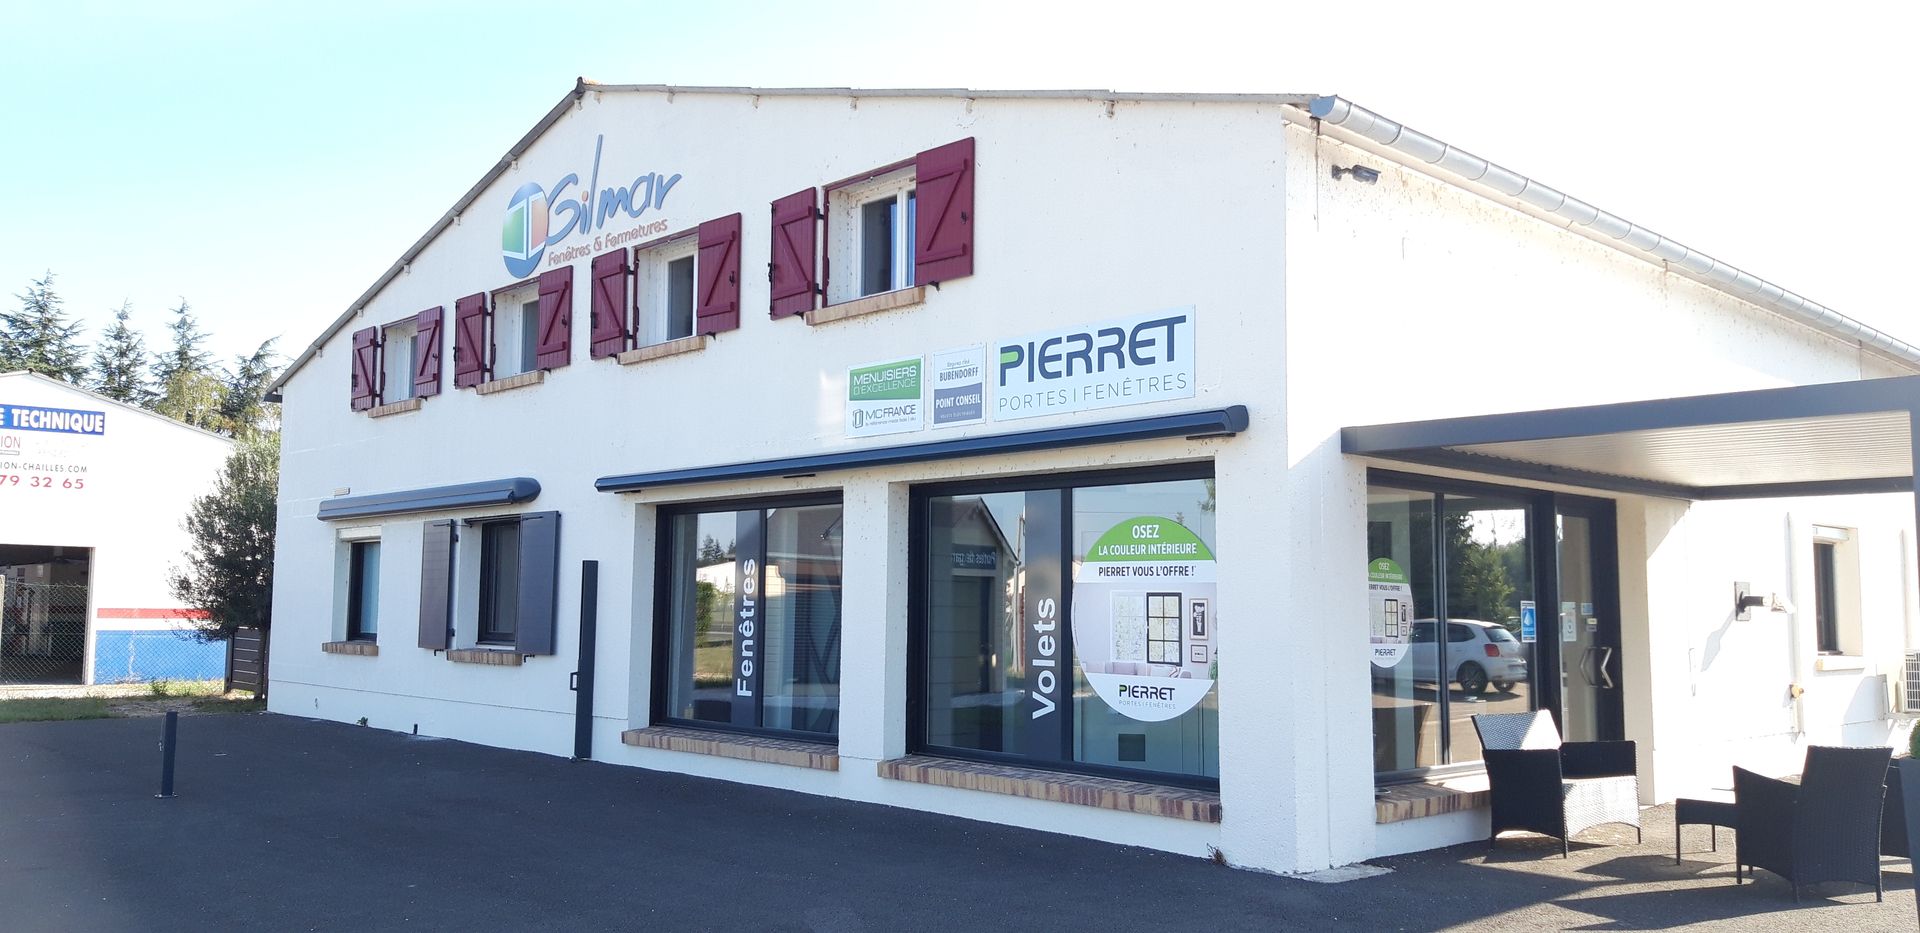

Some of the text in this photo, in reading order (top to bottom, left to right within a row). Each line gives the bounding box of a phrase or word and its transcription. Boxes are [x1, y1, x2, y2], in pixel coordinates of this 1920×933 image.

[545, 134, 682, 246] Gilmar
[593, 236, 603, 252] &
[1000, 315, 1186, 386] PIERRET
[853, 366, 917, 386] MENUISIERS
[940, 366, 979, 382] BUBENDORFF
[1000, 372, 1187, 412] PORTES FENÊTRES
[936, 393, 981, 409] POINT CONSEIL
[11, 408, 104, 432] TECHNIQUE
[30, 476, 52, 488] 32
[62, 478, 84, 490] 65
[1132, 524, 1159, 539] OSEZ
[1098, 541, 1197, 556] LA COULEUR INTÉRIEURE
[1098, 566, 1130, 577] PIERRET
[1132, 566, 1154, 577] VOUS
[1156, 566, 1189, 577] L'OFFRE
[737, 558, 755, 697] Fenêtres
[1032, 598, 1056, 720] Volets
[1119, 685, 1175, 701] PIERRET
